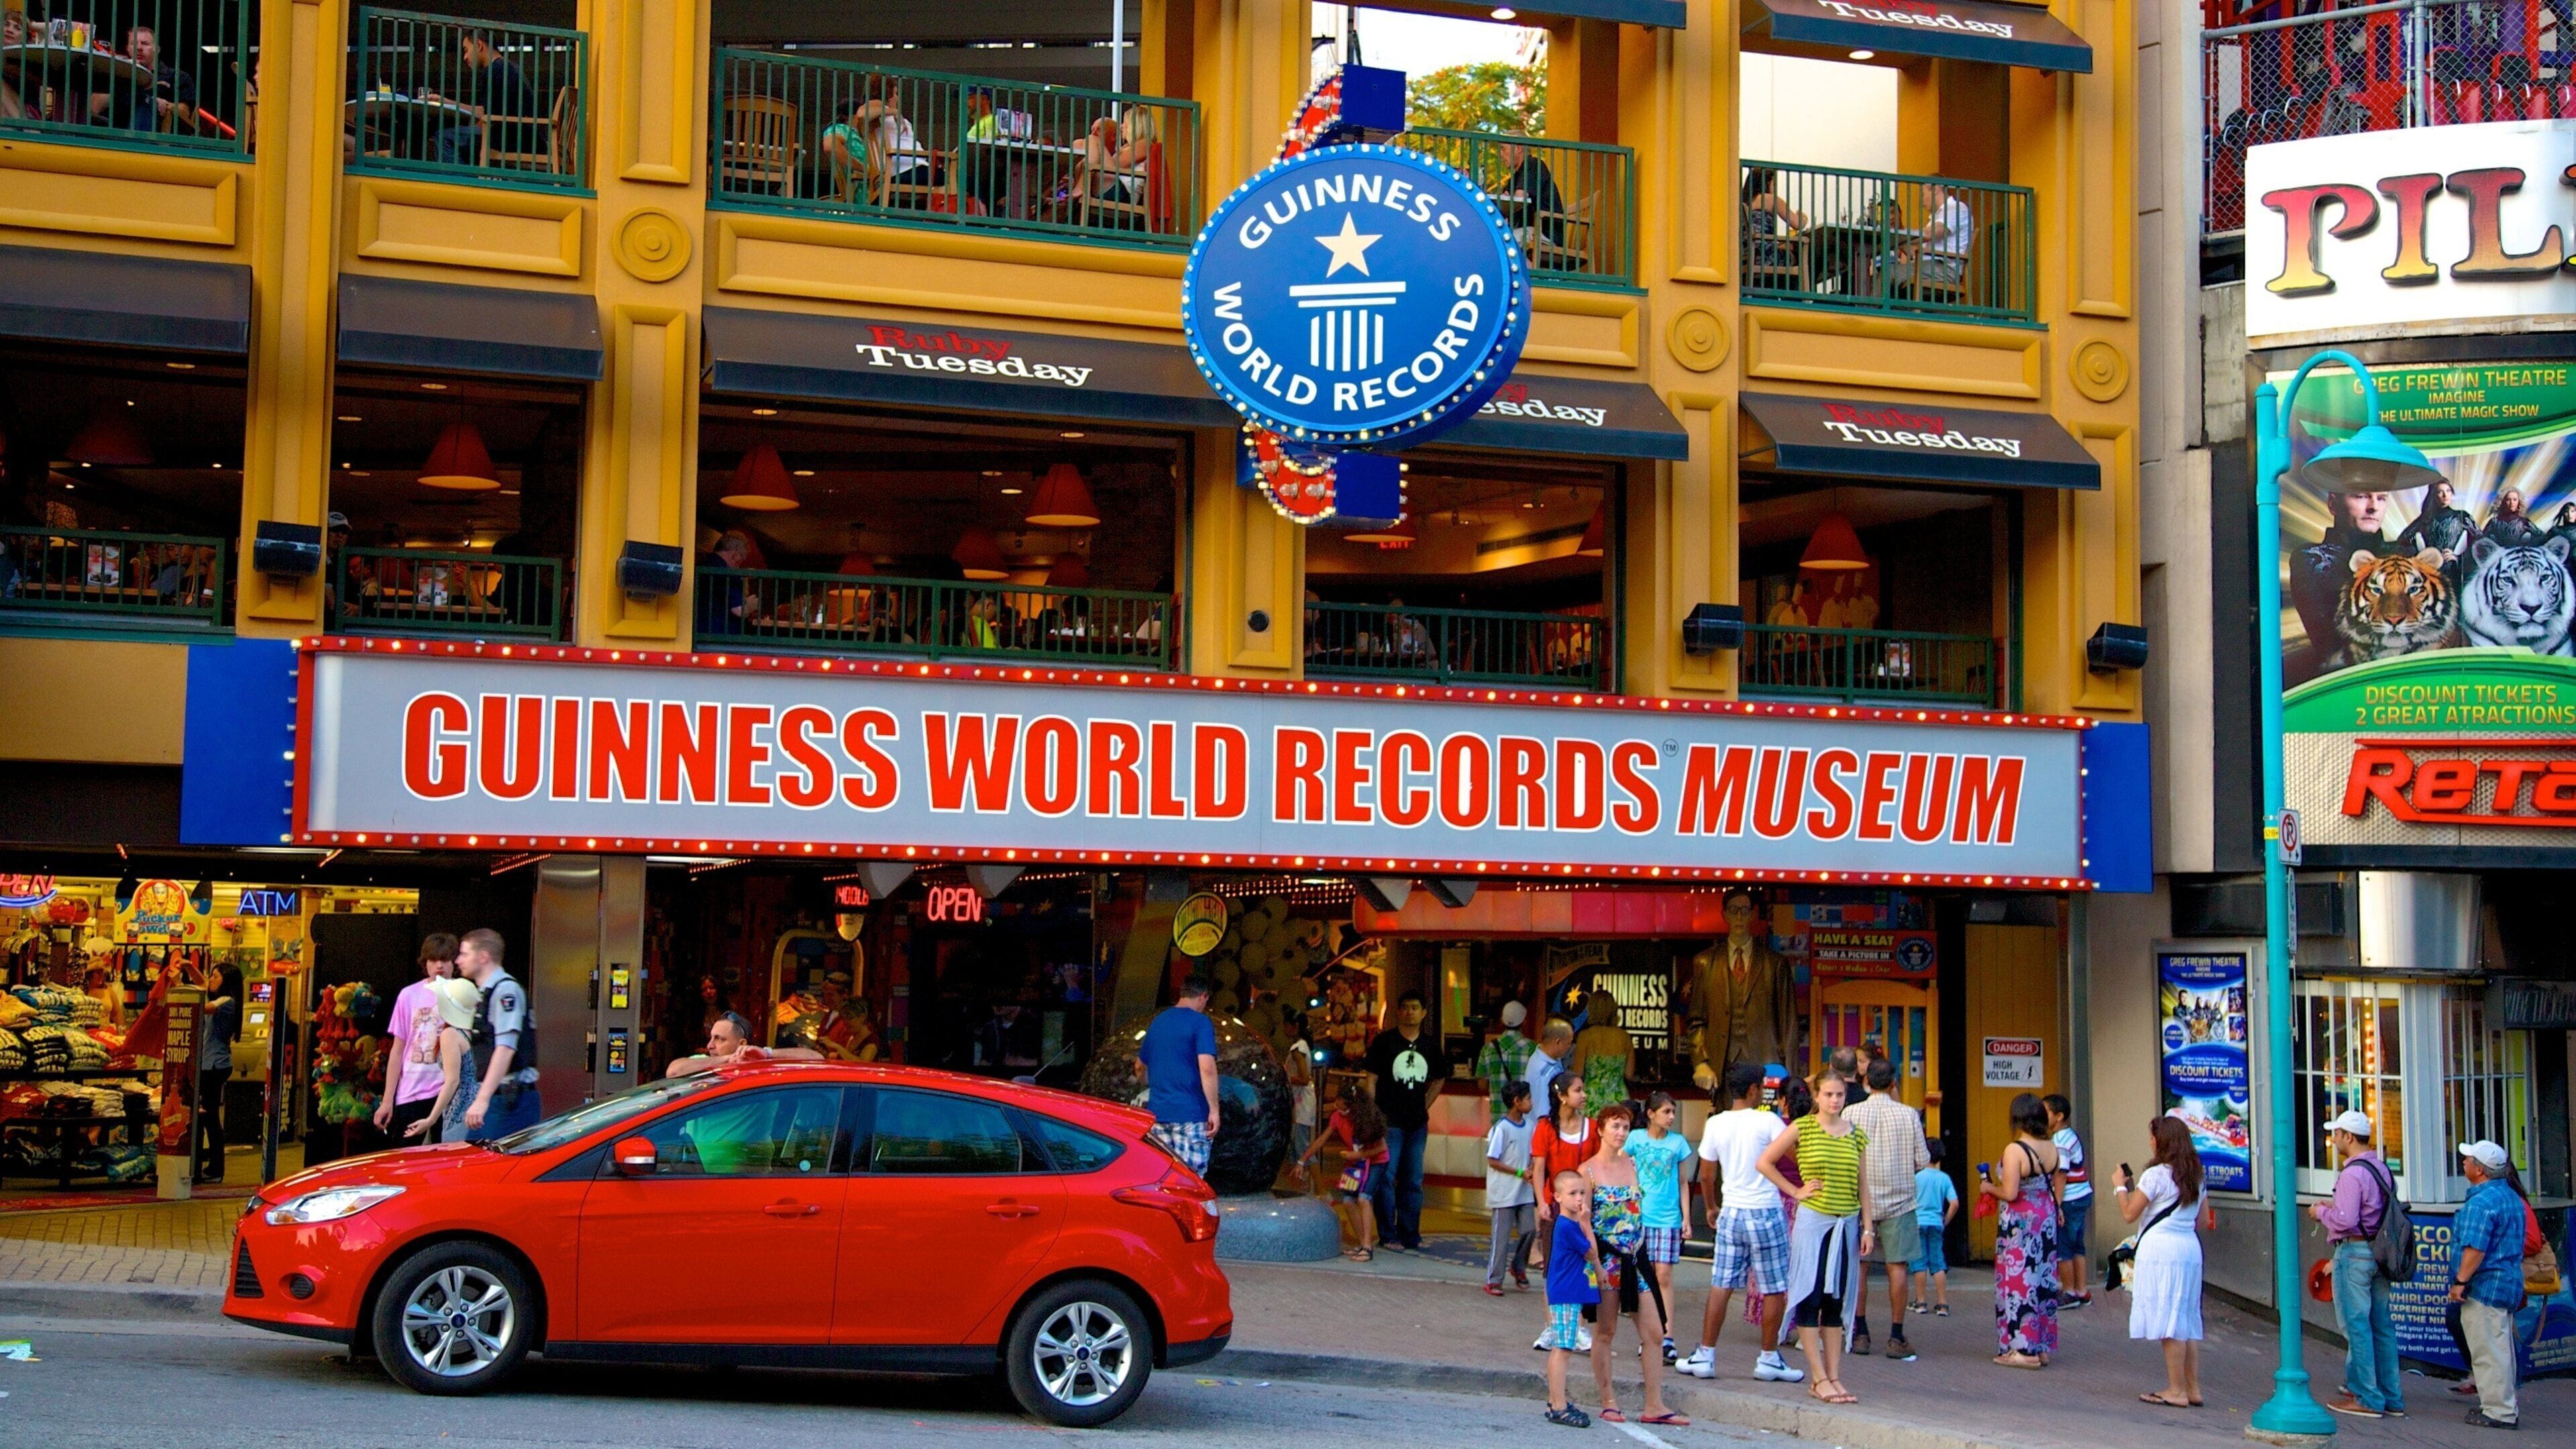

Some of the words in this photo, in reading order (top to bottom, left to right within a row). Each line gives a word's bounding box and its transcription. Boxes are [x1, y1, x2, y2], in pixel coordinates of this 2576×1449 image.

[1819, 0, 2013, 38] Tuesday
[1238, 174, 1461, 249] GUINNESS
[2261, 165, 2576, 299] PIL
[865, 325, 1013, 360] Ruby
[1214, 281, 1318, 405] WORLD
[1334, 274, 1485, 411] RECORDS
[855, 343, 1093, 387] Tuesday
[2353, 375, 2400, 394] GEG
[2406, 372, 2479, 391] FREWIN
[2484, 369, 2567, 388] THEATRE
[2428, 390, 2486, 405] IMAGINE
[1479, 399, 1607, 427] esday
[1820, 402, 1943, 434] Ruby
[2379, 410, 2396, 423] HE
[2400, 407, 2457, 422] ULTIMATE
[2461, 405, 2498, 419] MAGIC
[2502, 404, 2540, 417] SHOW
[1823, 421, 2021, 458] Tuesday
[2365, 684, 2469, 705] DISCOUNT
[2474, 684, 2557, 704] TICKETS
[2355, 707, 2367, 726] 2
[2373, 706, 2440, 725] GREAT
[2445, 705, 2576, 725] ATRACTIONS
[402, 690, 900, 812] GUINNESS
[921, 710, 1250, 822] WORLD
[1272, 725, 1662, 837] RECORDS
[1675, 742, 2027, 847] MUSEUM
[0, 875, 56, 896] PEN
[237, 890, 297, 916] ATM
[927, 886, 982, 922] OPEN
[1813, 932, 1847, 945] HAVE
[1849, 934, 1861, 945] A
[1864, 934, 1895, 946] SEAT
[1819, 949, 1839, 958] TAKE
[1840, 950, 1847, 958] A
[1848, 950, 1878, 959] PICTURE
[1880, 951, 1890, 960] IN
[2169, 957, 2186, 967] GREG
[2212, 957, 2241, 967] THEATRE
[178, 1007, 193, 1018] PURE
[1625, 1008, 1668, 1028] RECORDS
[168, 1018, 192, 1029] CANADIAN
[166, 1030, 191, 1046] MAPLE
[1631, 1036, 1668, 1049] EUM
[166, 1047, 190, 1064] SYRUP
[1993, 1042, 2033, 1053] DANGER
[1992, 1060, 2012, 1069] HIGH
[2169, 1065, 2210, 1076] DISCOUNT
[2211, 1067, 2244, 1077] TICKETS
[1986, 1071, 2021, 1081] VOLTAGE
[2416, 1263, 2449, 1275] FREW
[2402, 1281, 2447, 1291] ULTIMATE
[2424, 1275, 2449, 1283] IMAG
[2389, 1292, 2450, 1305] WHIRLPOO
[2390, 1313, 2405, 1322] ON
[2406, 1314, 2427, 1324] THE
[2428, 1315, 2447, 1325] NIA
[2395, 1331, 2423, 1340] Niagara
[2424, 1332, 2441, 1341] Falls
[2408, 1326, 2424, 1334] your
[2425, 1326, 2449, 1334] tickets
[2398, 1344, 2407, 1352] uy
[2408, 1344, 2424, 1352] both
[2425, 1345, 2439, 1353] and
[2440, 1346, 2451, 1354] get
